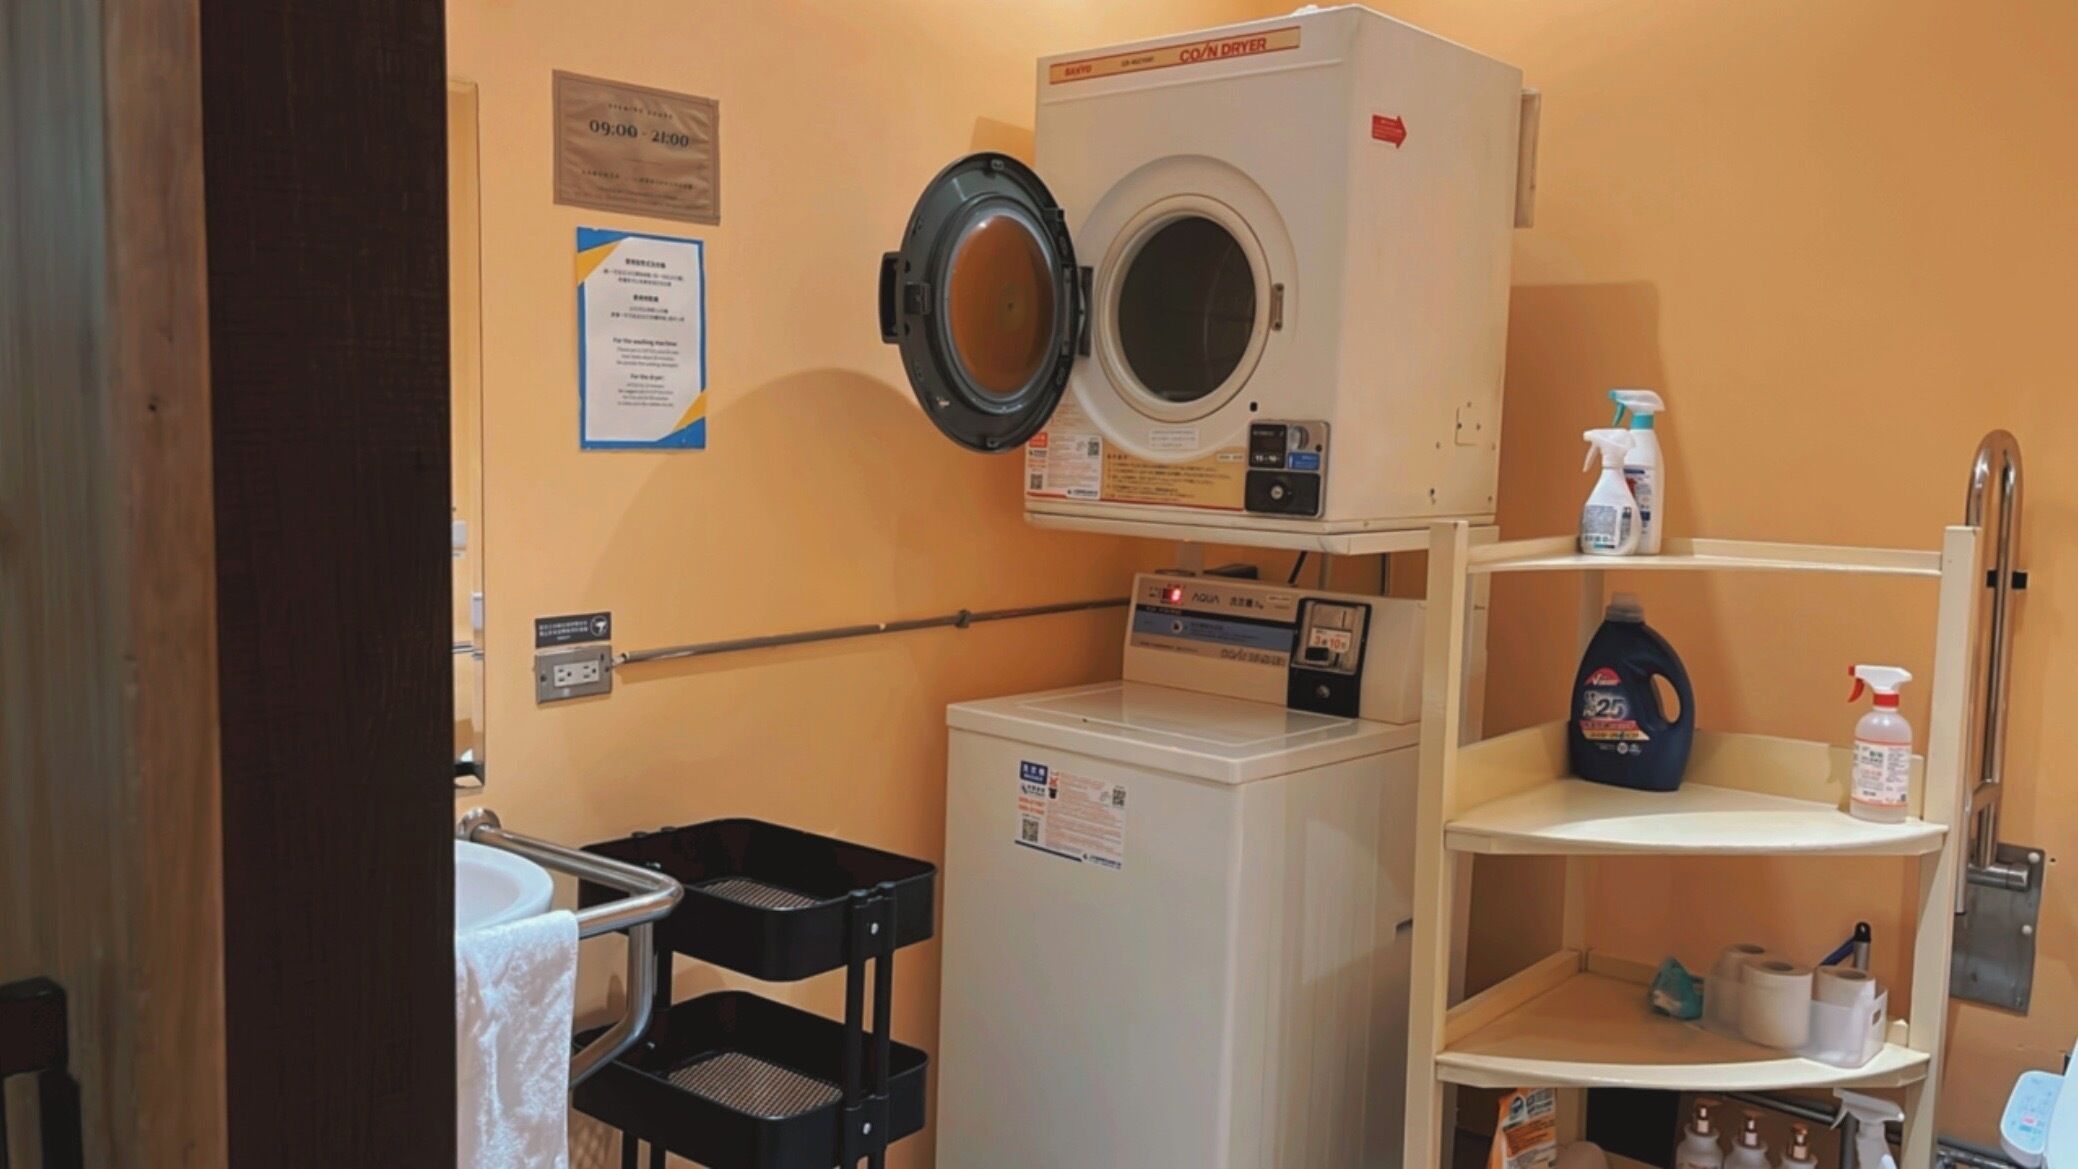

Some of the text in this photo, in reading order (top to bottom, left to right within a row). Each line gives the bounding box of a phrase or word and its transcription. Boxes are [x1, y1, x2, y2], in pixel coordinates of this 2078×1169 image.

[1221, 37, 1267, 56] DRYER
[1065, 64, 1092, 76] SANYO
[589, 119, 638, 139] 09:00
[651, 130, 689, 148] 21:00
[1191, 592, 1220, 604] AQUA
